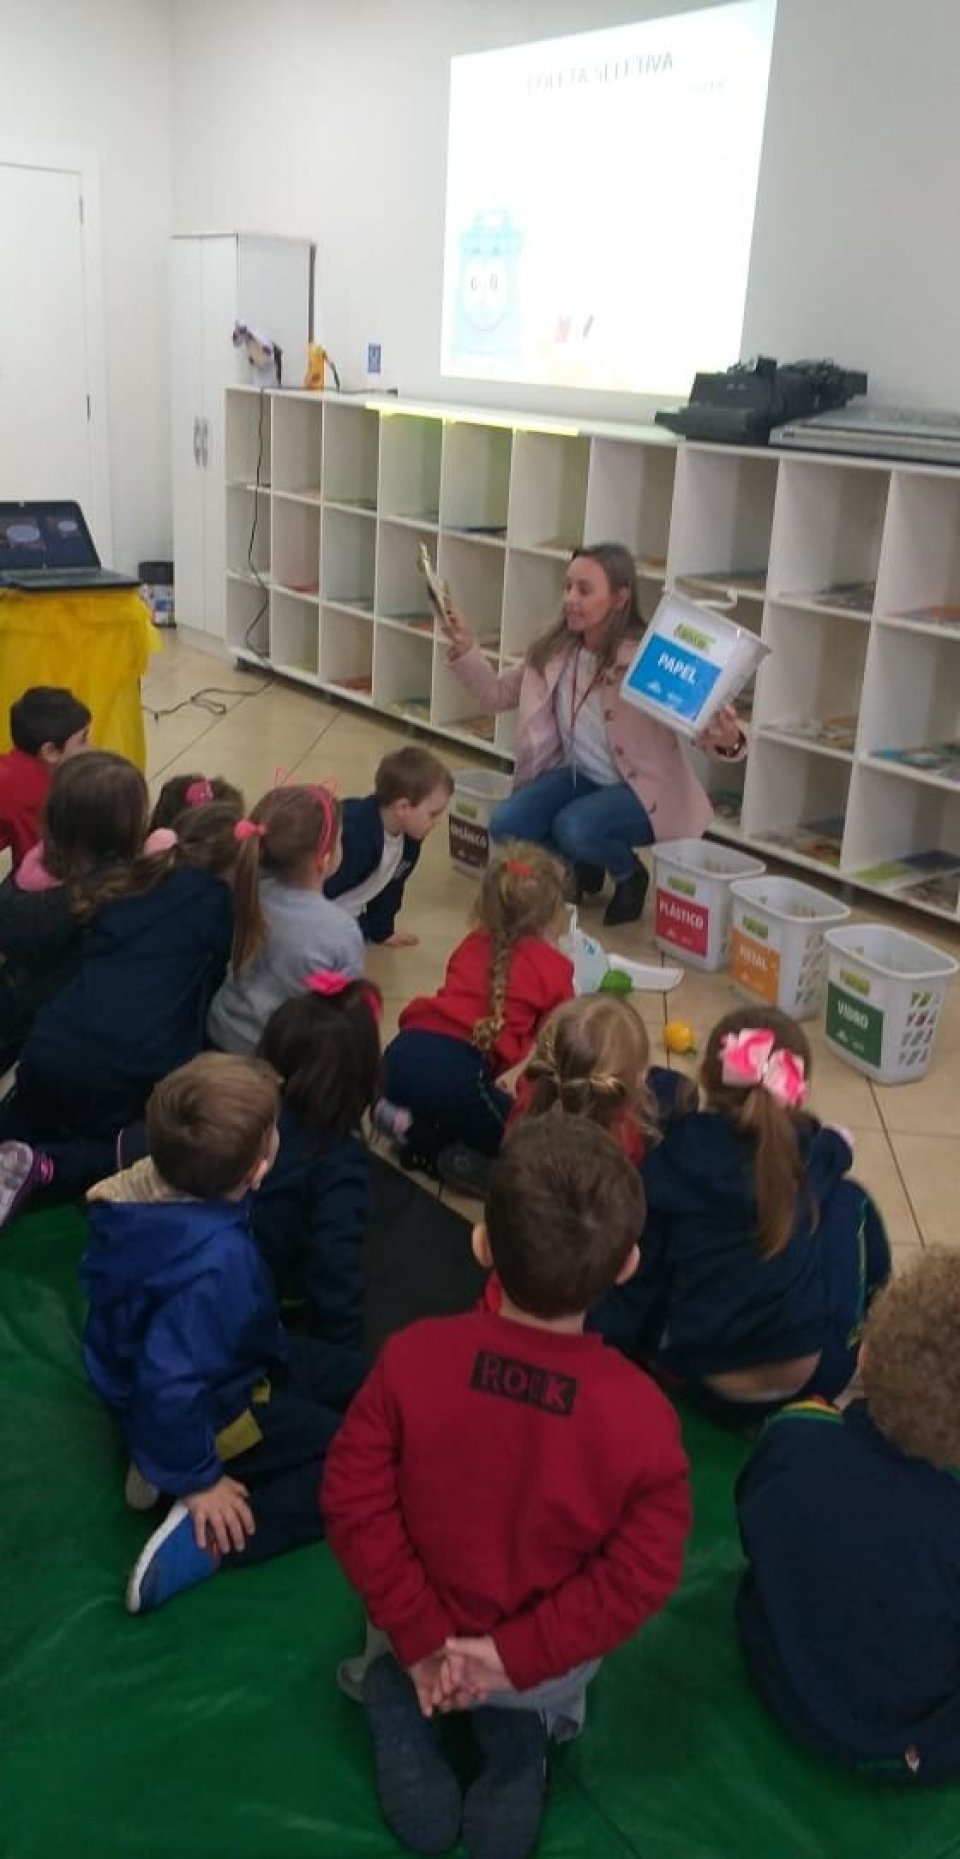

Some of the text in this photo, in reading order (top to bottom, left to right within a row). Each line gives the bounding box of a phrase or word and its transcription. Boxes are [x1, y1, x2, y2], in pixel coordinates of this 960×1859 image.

[658, 652, 697, 685] PAPEL
[659, 898, 704, 930] PLÁSTICO
[739, 944, 769, 972] METAL
[837, 1000, 869, 1030] VIDRO
